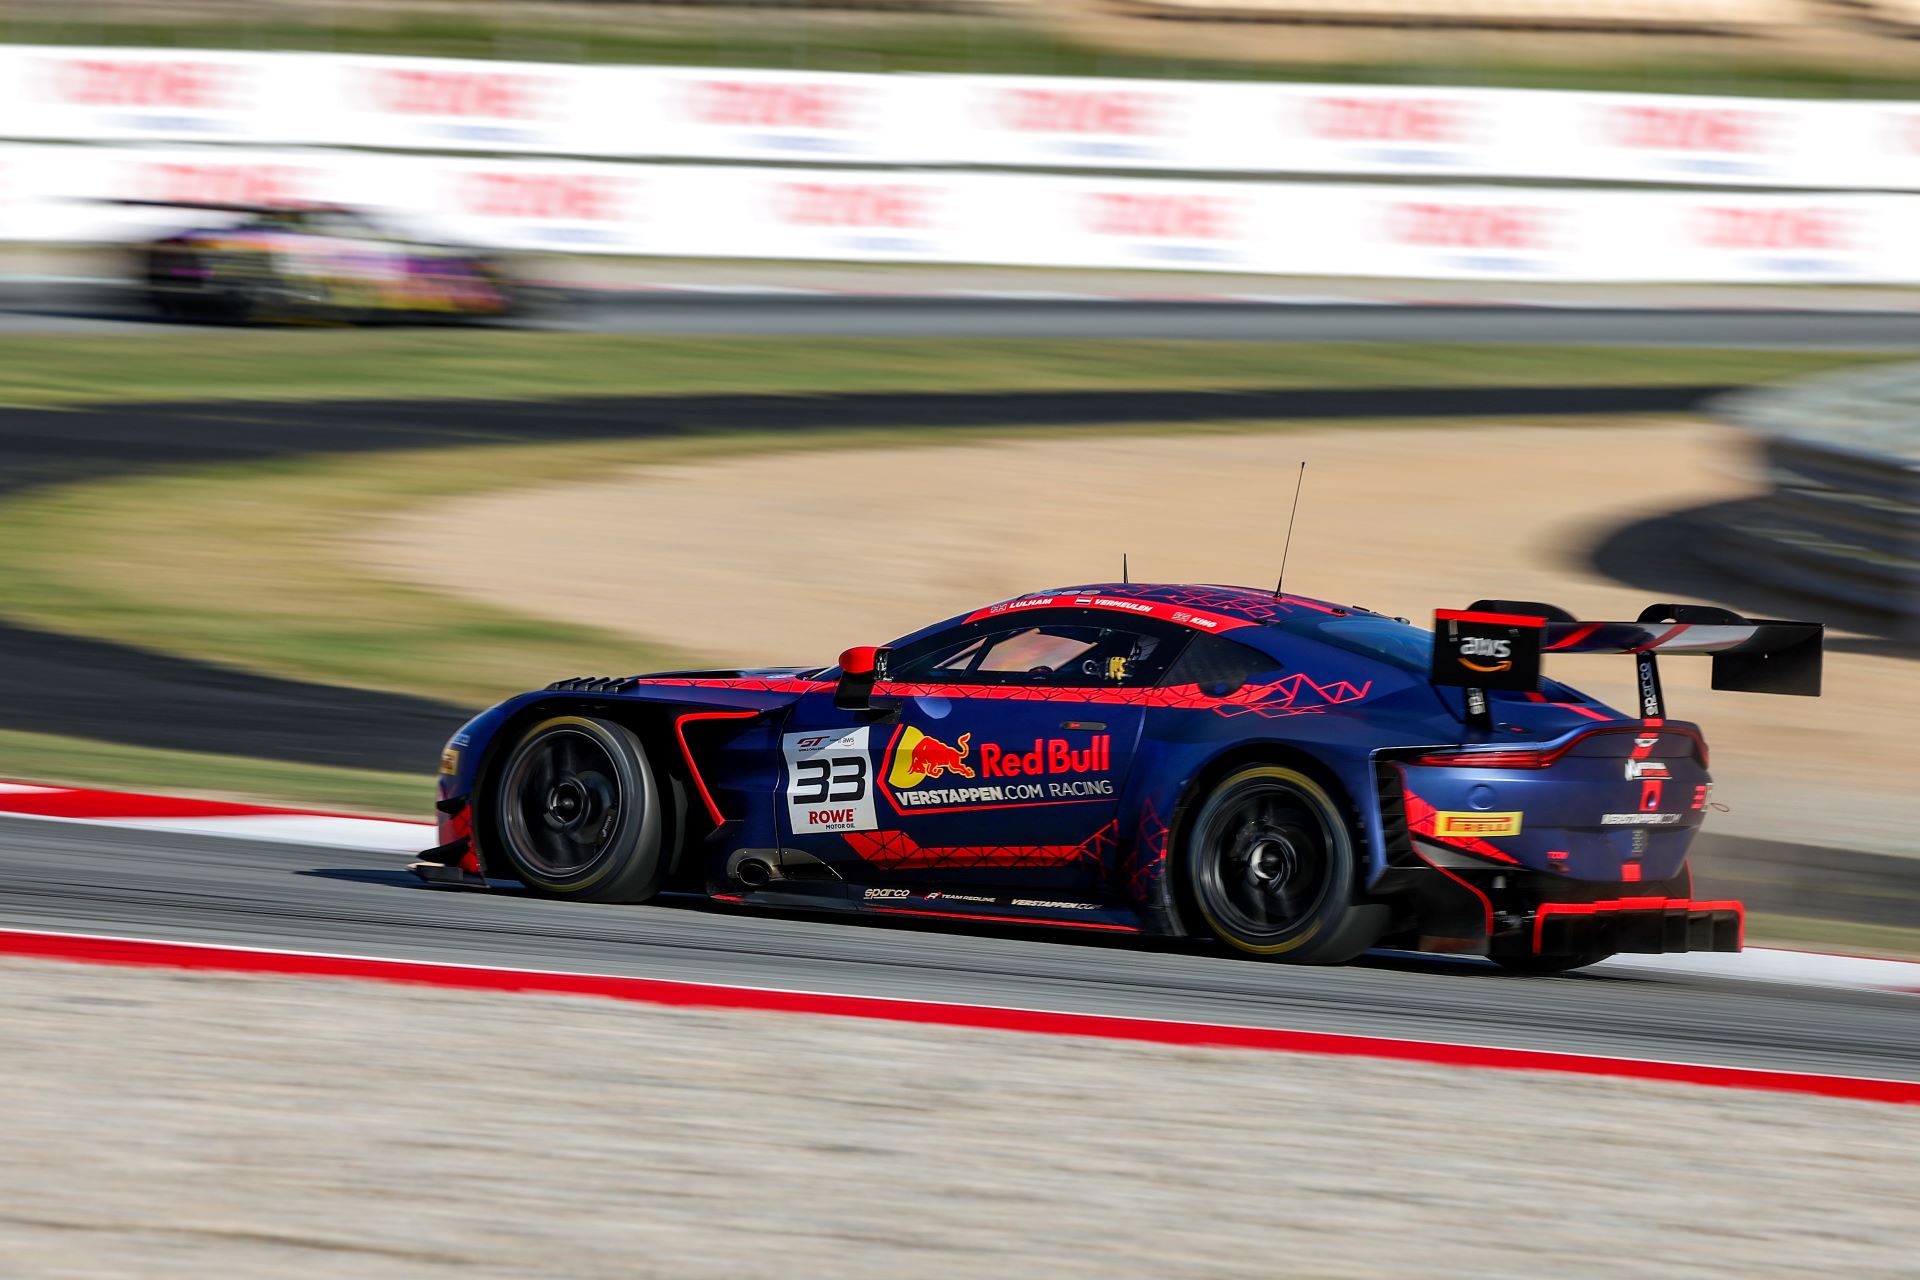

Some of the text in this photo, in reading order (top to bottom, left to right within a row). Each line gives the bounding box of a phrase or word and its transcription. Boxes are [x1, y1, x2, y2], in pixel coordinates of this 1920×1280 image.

[1009, 598, 1053, 609] LULHAM
[1094, 598, 1153, 612] VERMEULEN
[1189, 616, 1218, 628] KING
[1460, 637, 1511, 658] aws
[1639, 662, 1659, 715] sparco
[797, 736, 830, 748] GT
[980, 734, 1110, 778] Red Bull
[793, 756, 867, 804] 33
[895, 779, 1114, 807] VERSTAPPEN.COM RACING
[808, 808, 854, 825] ROWE
[864, 888, 911, 899] sparco
[963, 895, 996, 903] REDLINE
